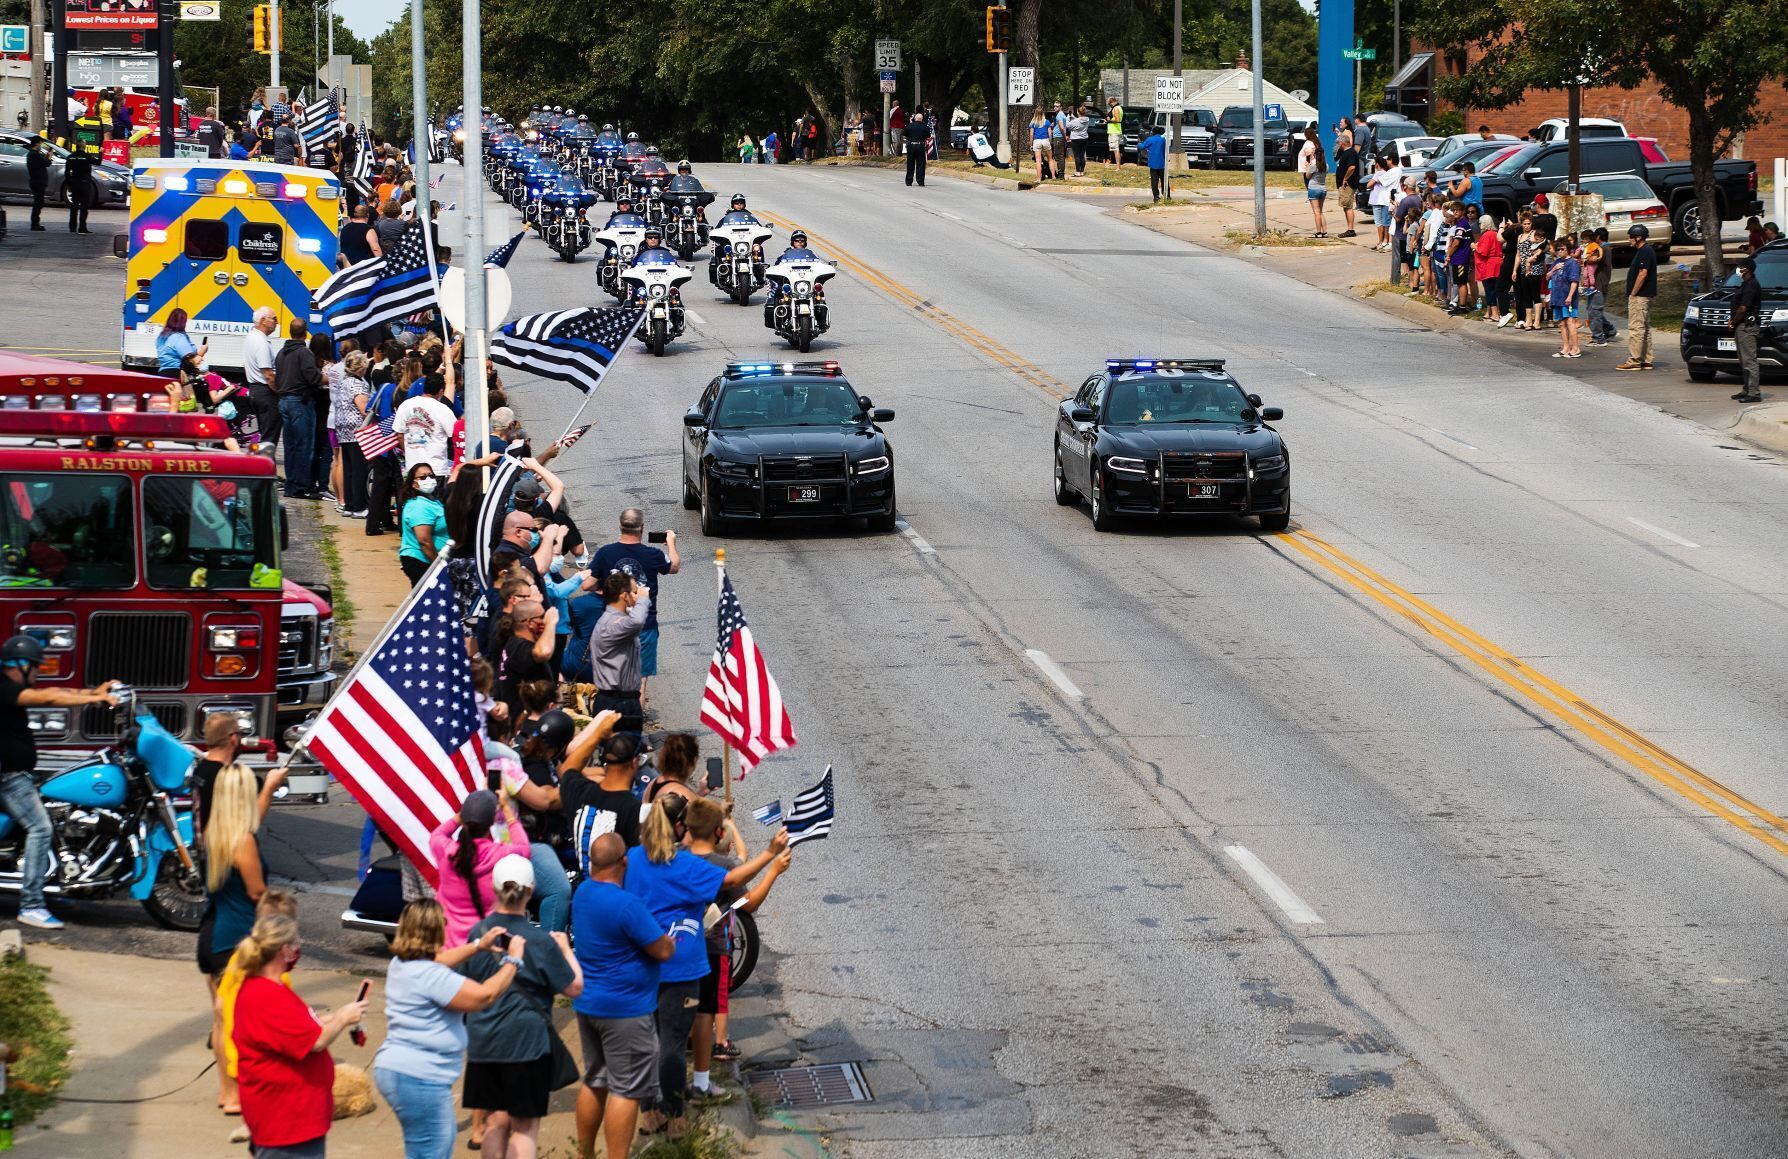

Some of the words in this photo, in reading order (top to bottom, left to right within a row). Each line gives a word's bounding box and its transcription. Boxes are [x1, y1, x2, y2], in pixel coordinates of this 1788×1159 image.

[131, 16, 156, 24] Liquor
[1343, 50, 1361, 58] Valley
[879, 56, 896, 67] 35
[1157, 80, 1166, 88] DO
[1170, 80, 1182, 88] NOT
[1157, 92, 1181, 100] BLOCK
[242, 239, 279, 248] Children's
[60, 457, 152, 471] RALSTON
[163, 459, 212, 472] FIRE
[802, 489, 817, 498] 299
[1201, 485, 1217, 494] 307
